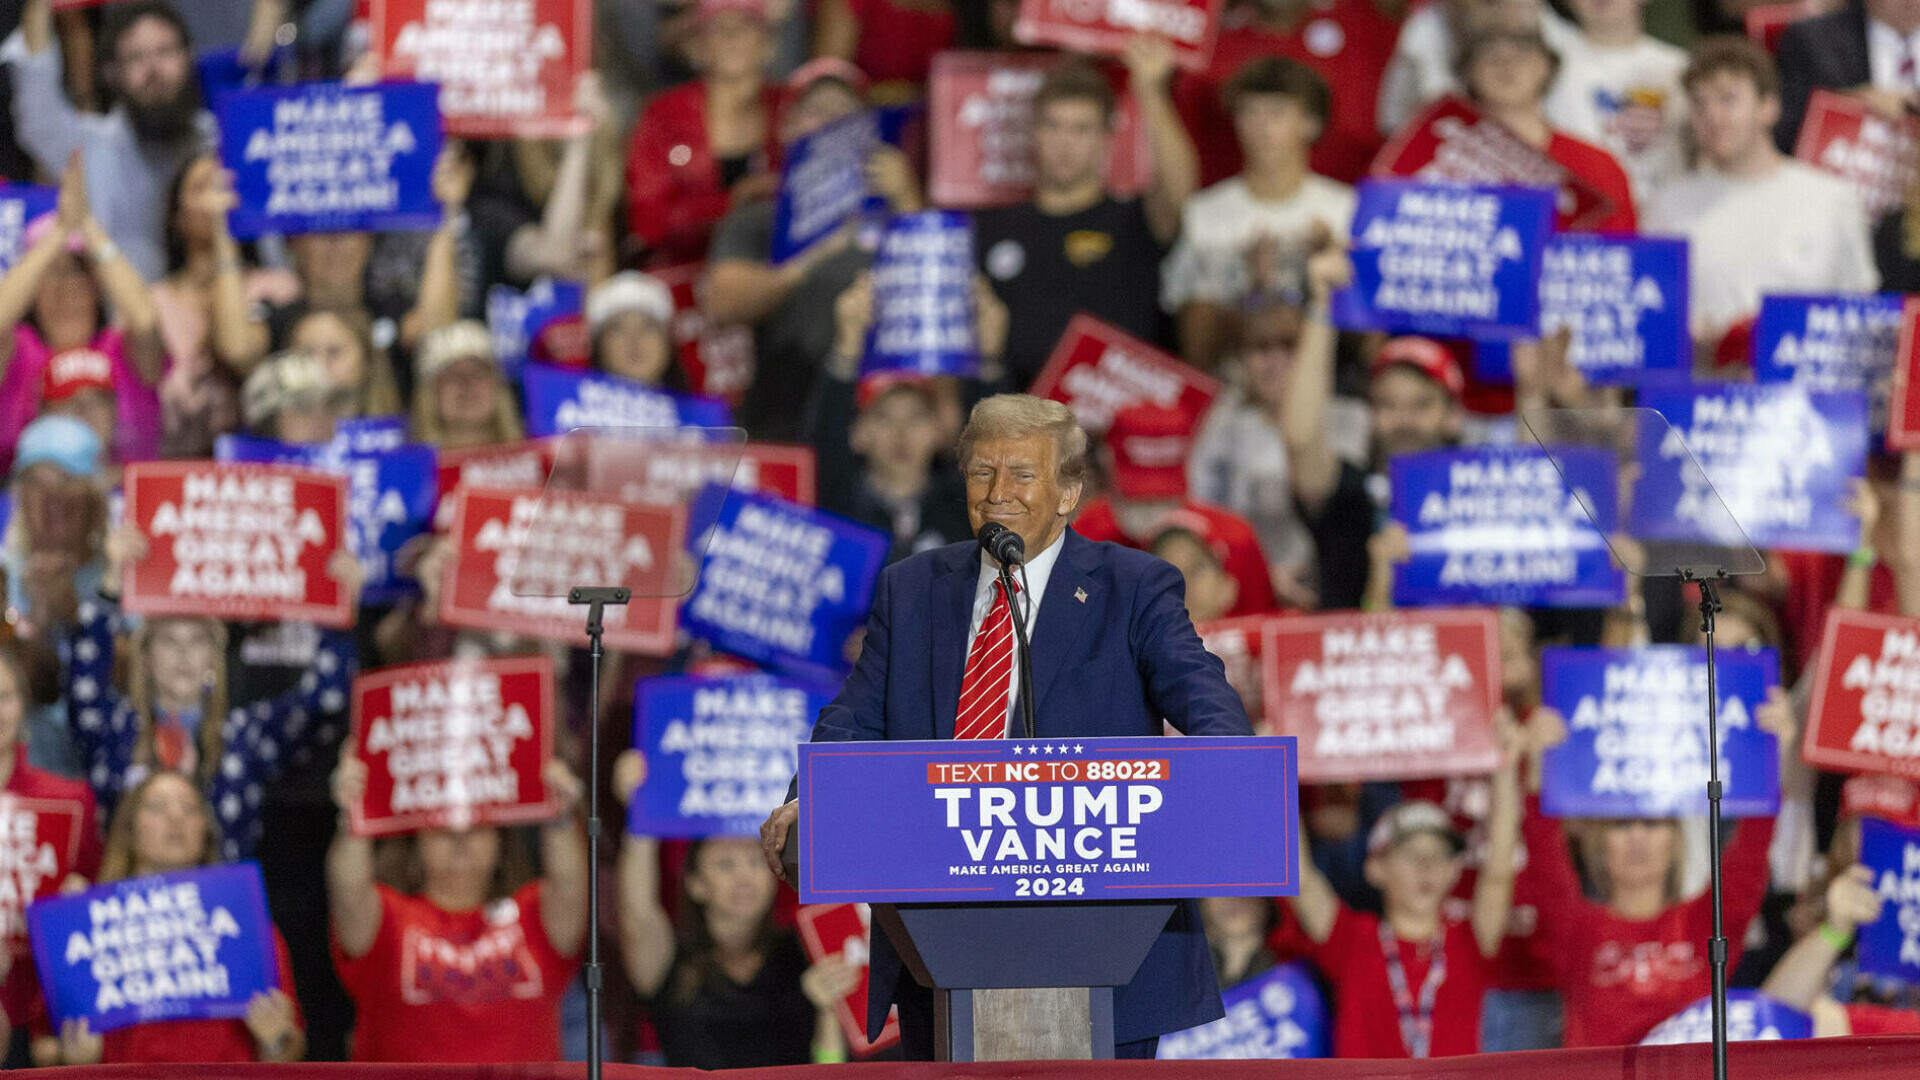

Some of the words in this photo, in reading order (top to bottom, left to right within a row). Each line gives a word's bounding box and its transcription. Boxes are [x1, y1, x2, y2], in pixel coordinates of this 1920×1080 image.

[182, 474, 296, 504] MAKE
[151, 500, 326, 545] AMERICA
[172, 532, 301, 565] GREAT
[170, 563, 307, 601] AGAIN!
[1321, 622, 1438, 657] MAKE
[391, 674, 501, 714] MAKE
[1291, 651, 1474, 697] AMERICA
[1314, 684, 1449, 722] GREAT
[366, 701, 534, 755] AMERICA
[1315, 717, 1456, 757] AGAIN!
[387, 733, 514, 780] GREAT
[936, 764, 997, 782] TEXT
[1005, 763, 1040, 781] NC
[1047, 762, 1079, 781] TO
[1086, 761, 1161, 780] 88022
[391, 766, 520, 814] AGAIN!
[934, 785, 1163, 827] TRUMP
[961, 827, 1137, 861] VANCE
[950, 865, 987, 875] MAKE
[991, 864, 1051, 875] AMERICA
[1056, 863, 1099, 873] GREAT
[1103, 862, 1150, 872] AGAIN!
[1015, 877, 1085, 896] 2024
[89, 881, 200, 926] MAKE
[66, 906, 241, 966] AMERICA
[91, 932, 223, 983] GREAT
[95, 962, 230, 1015] AGAIN!
